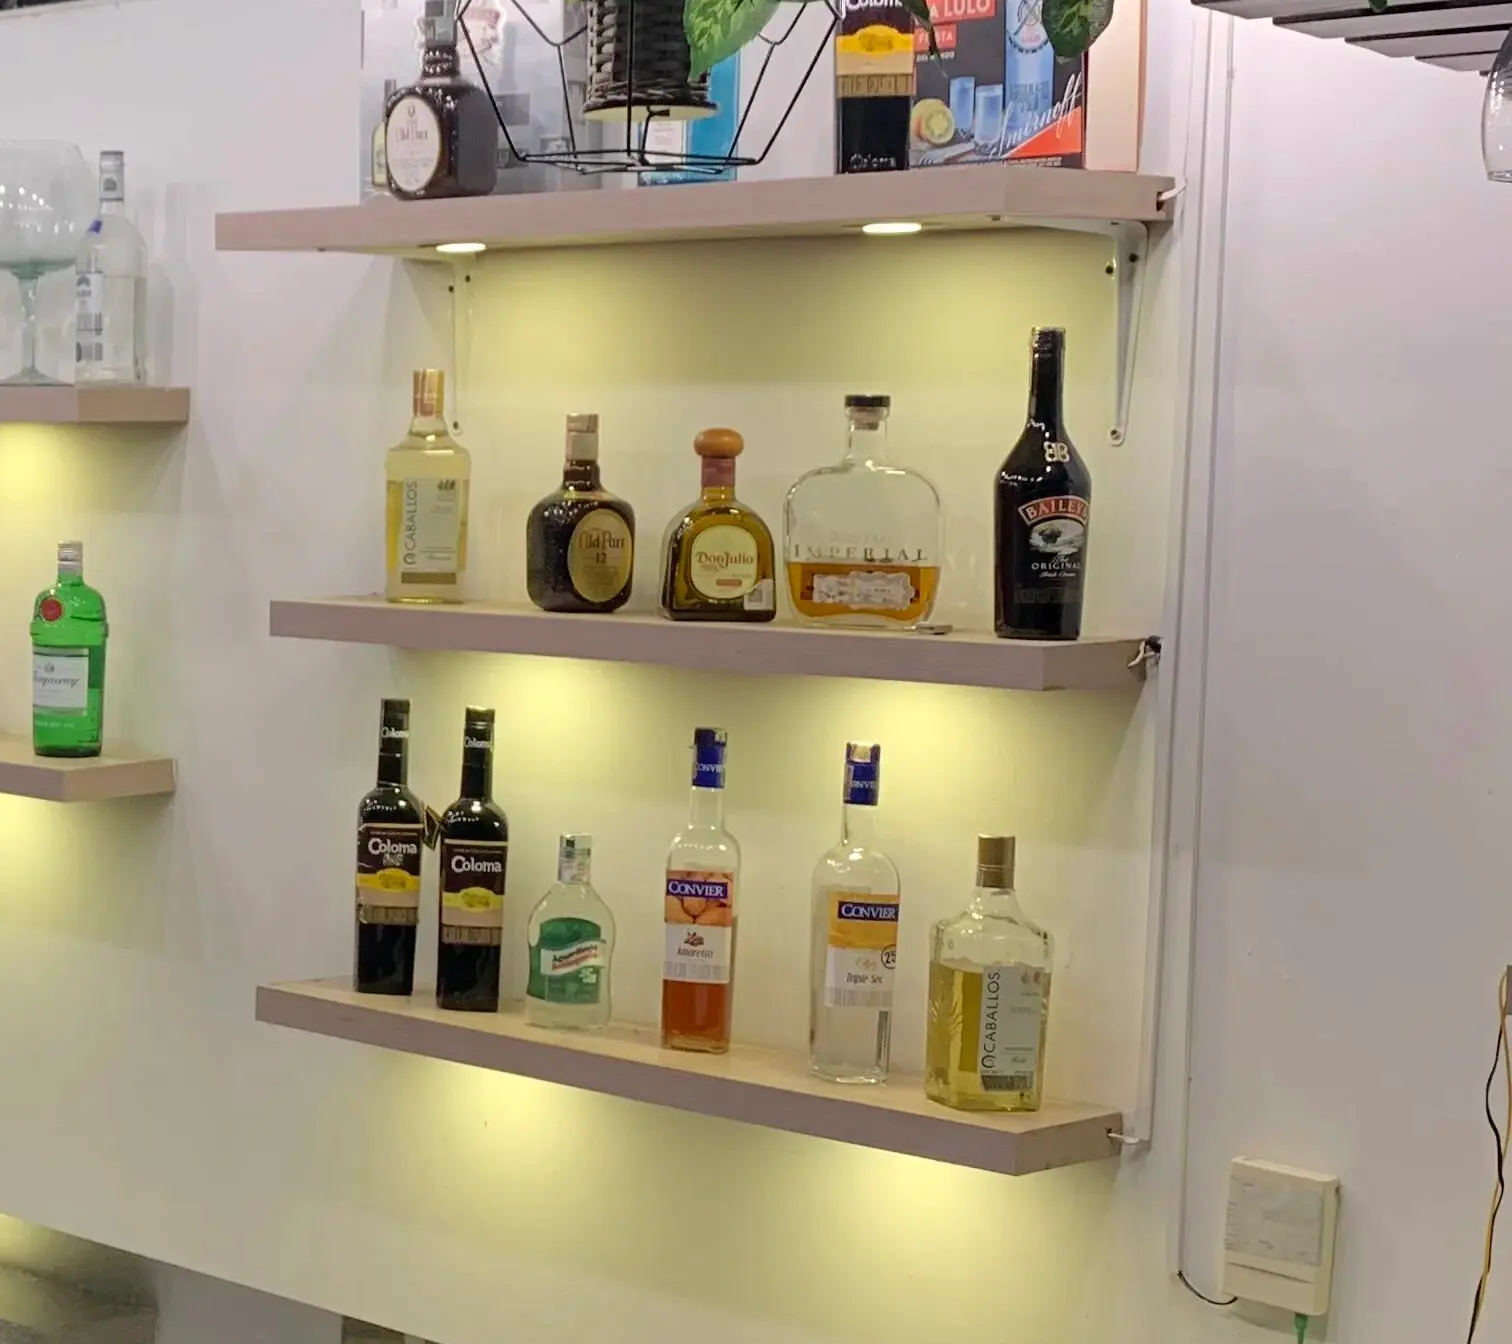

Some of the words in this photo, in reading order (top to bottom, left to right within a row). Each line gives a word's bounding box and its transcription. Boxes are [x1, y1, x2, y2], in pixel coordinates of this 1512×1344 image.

[989, 71, 1082, 159] Smirnoff
[404, 480, 418, 551] CABALLOS
[595, 552, 607, 564] 12
[793, 544, 929, 562] IMPERIAL
[464, 736, 491, 749] Colom
[367, 837, 418, 855] Coloma
[451, 855, 502, 873] Coloma
[668, 881, 724, 898] CONVIER
[841, 904, 897, 920] CONVIER
[983, 971, 1002, 1053] CABALLOS
